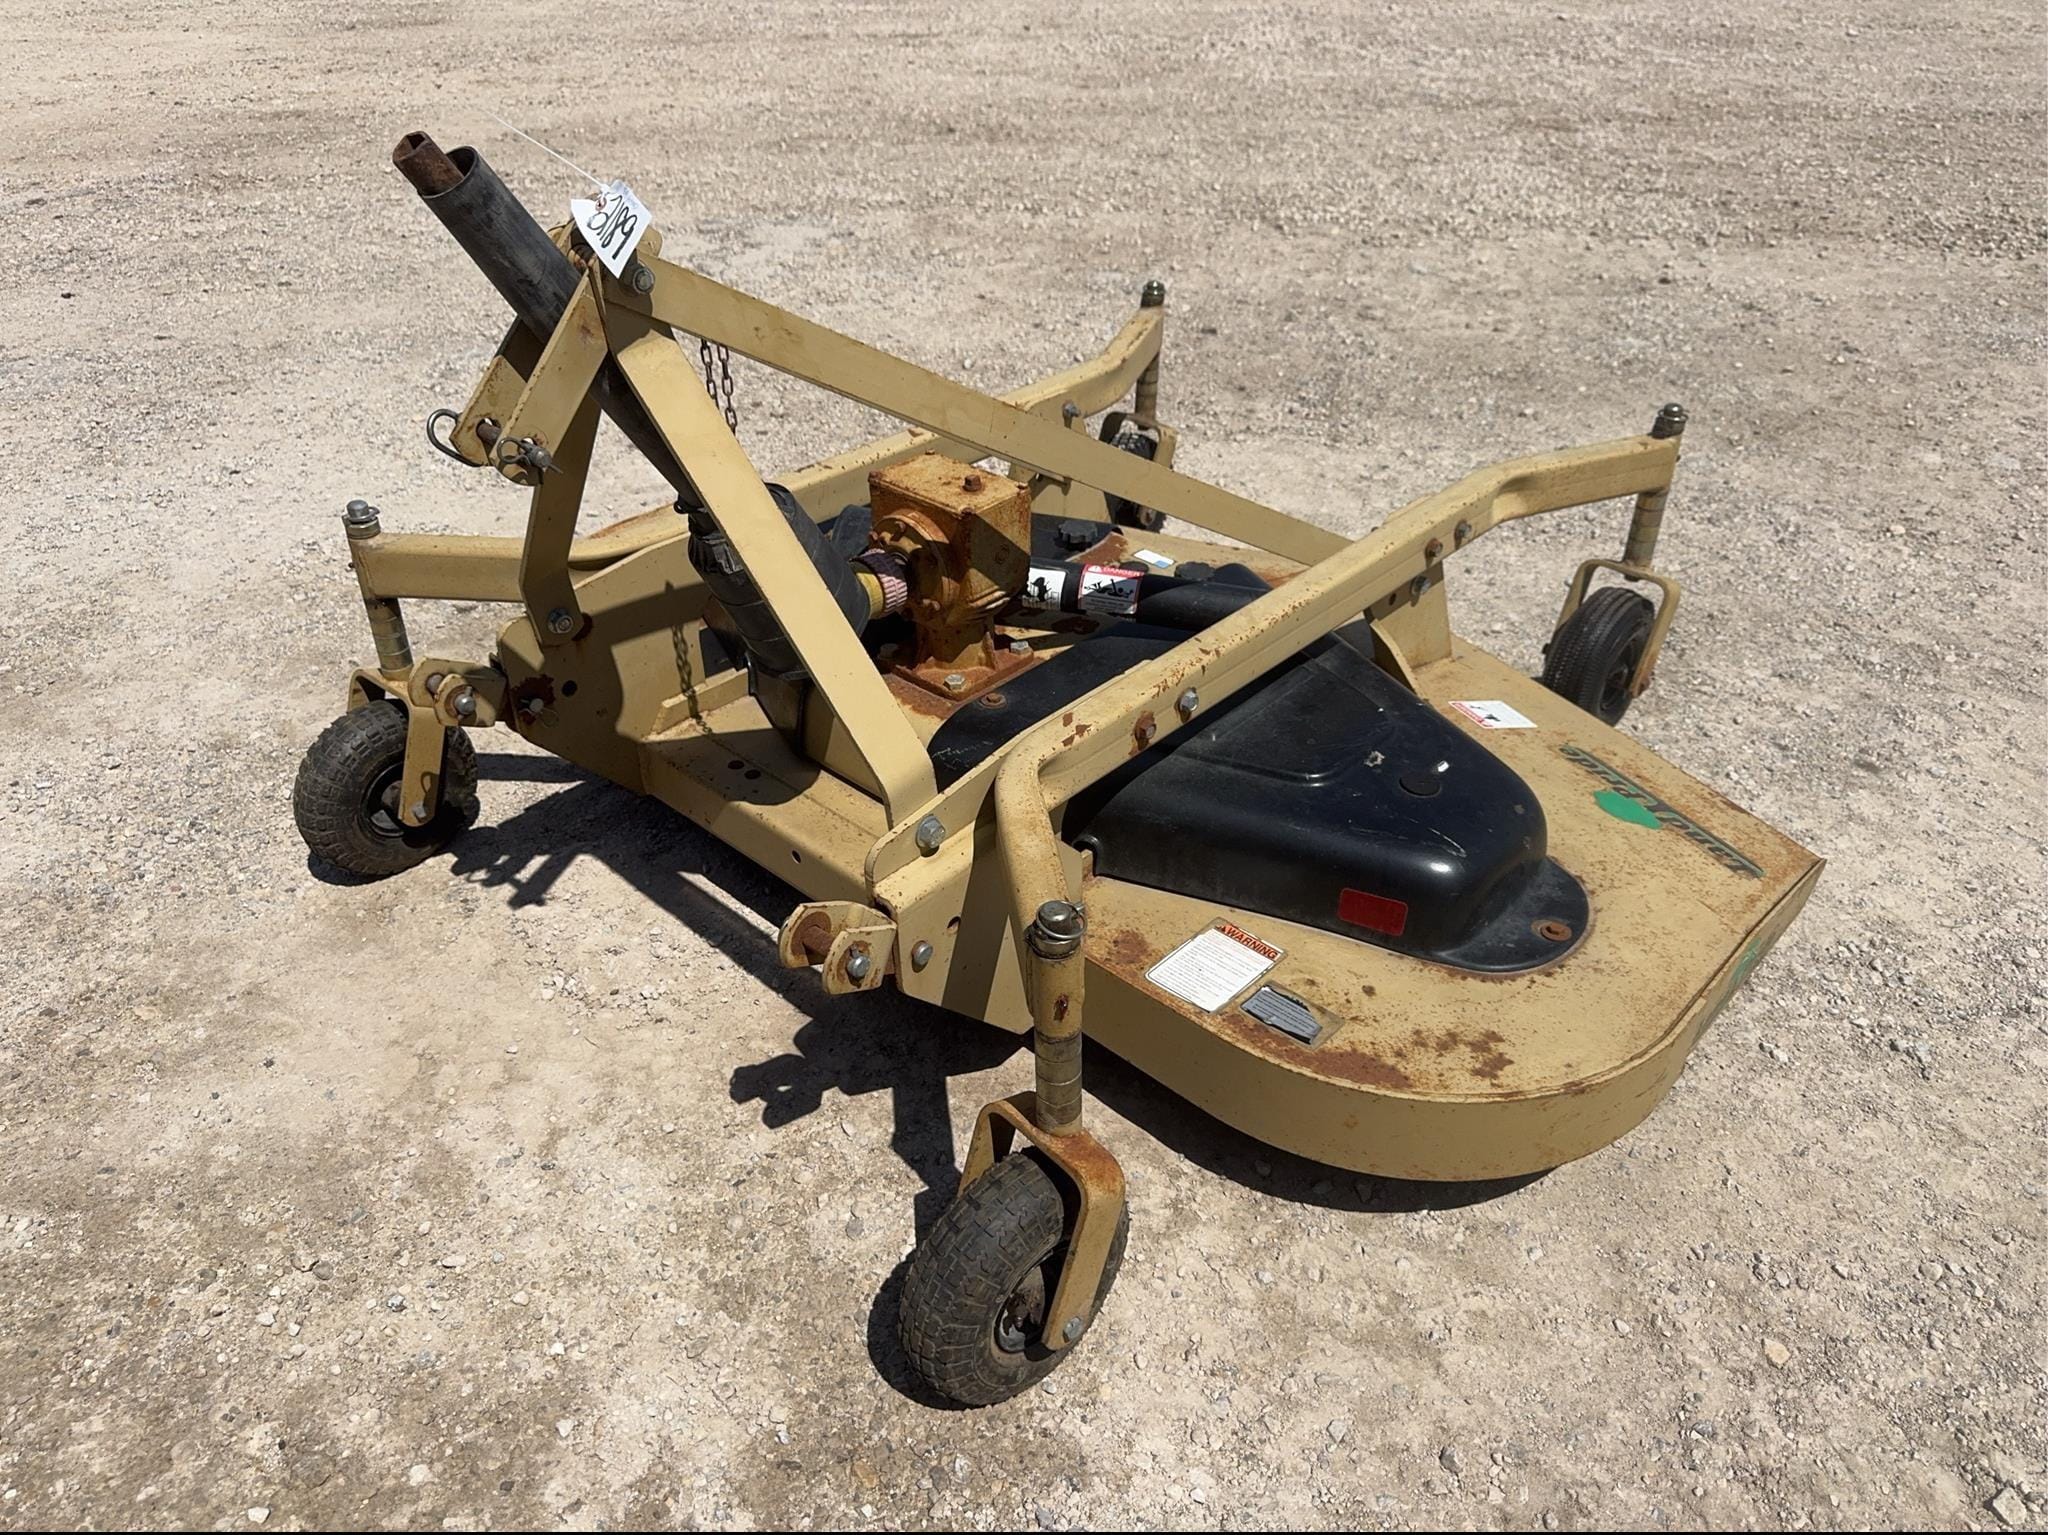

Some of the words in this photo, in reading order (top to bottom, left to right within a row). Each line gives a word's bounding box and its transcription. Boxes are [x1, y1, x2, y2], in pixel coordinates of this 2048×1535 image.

[1557, 748, 1645, 798] Pride
[1654, 817, 1757, 876] Land
[1228, 926, 1279, 960] WARNING
